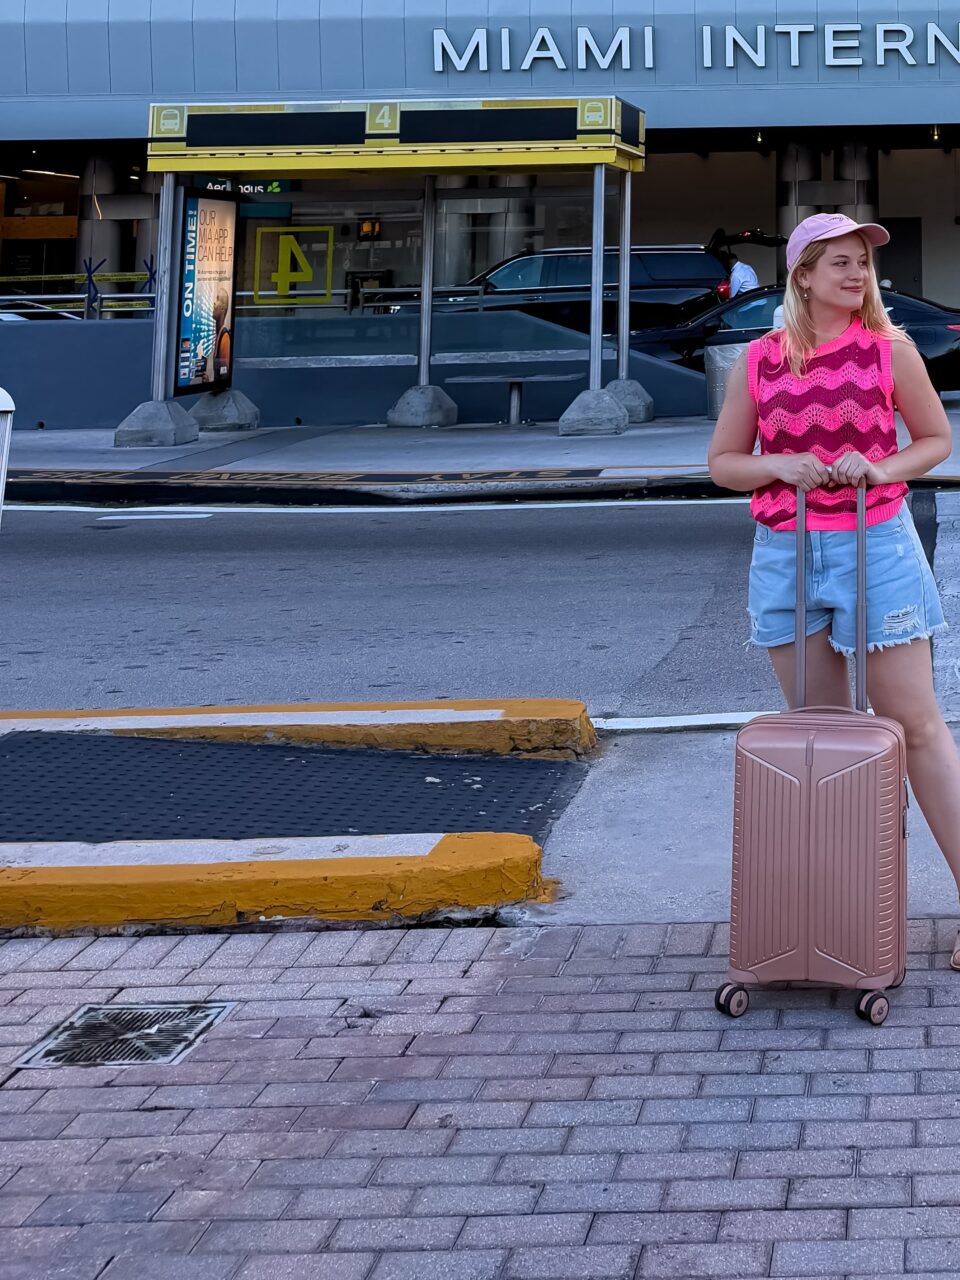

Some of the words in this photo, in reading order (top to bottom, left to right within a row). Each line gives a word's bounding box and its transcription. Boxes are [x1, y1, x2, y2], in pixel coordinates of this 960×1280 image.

[433, 26, 654, 71] MIAMI
[375, 105, 392, 128] 4
[199, 209, 217, 226] OUR
[197, 245, 214, 262] CAN
[183, 282, 194, 318] ON
